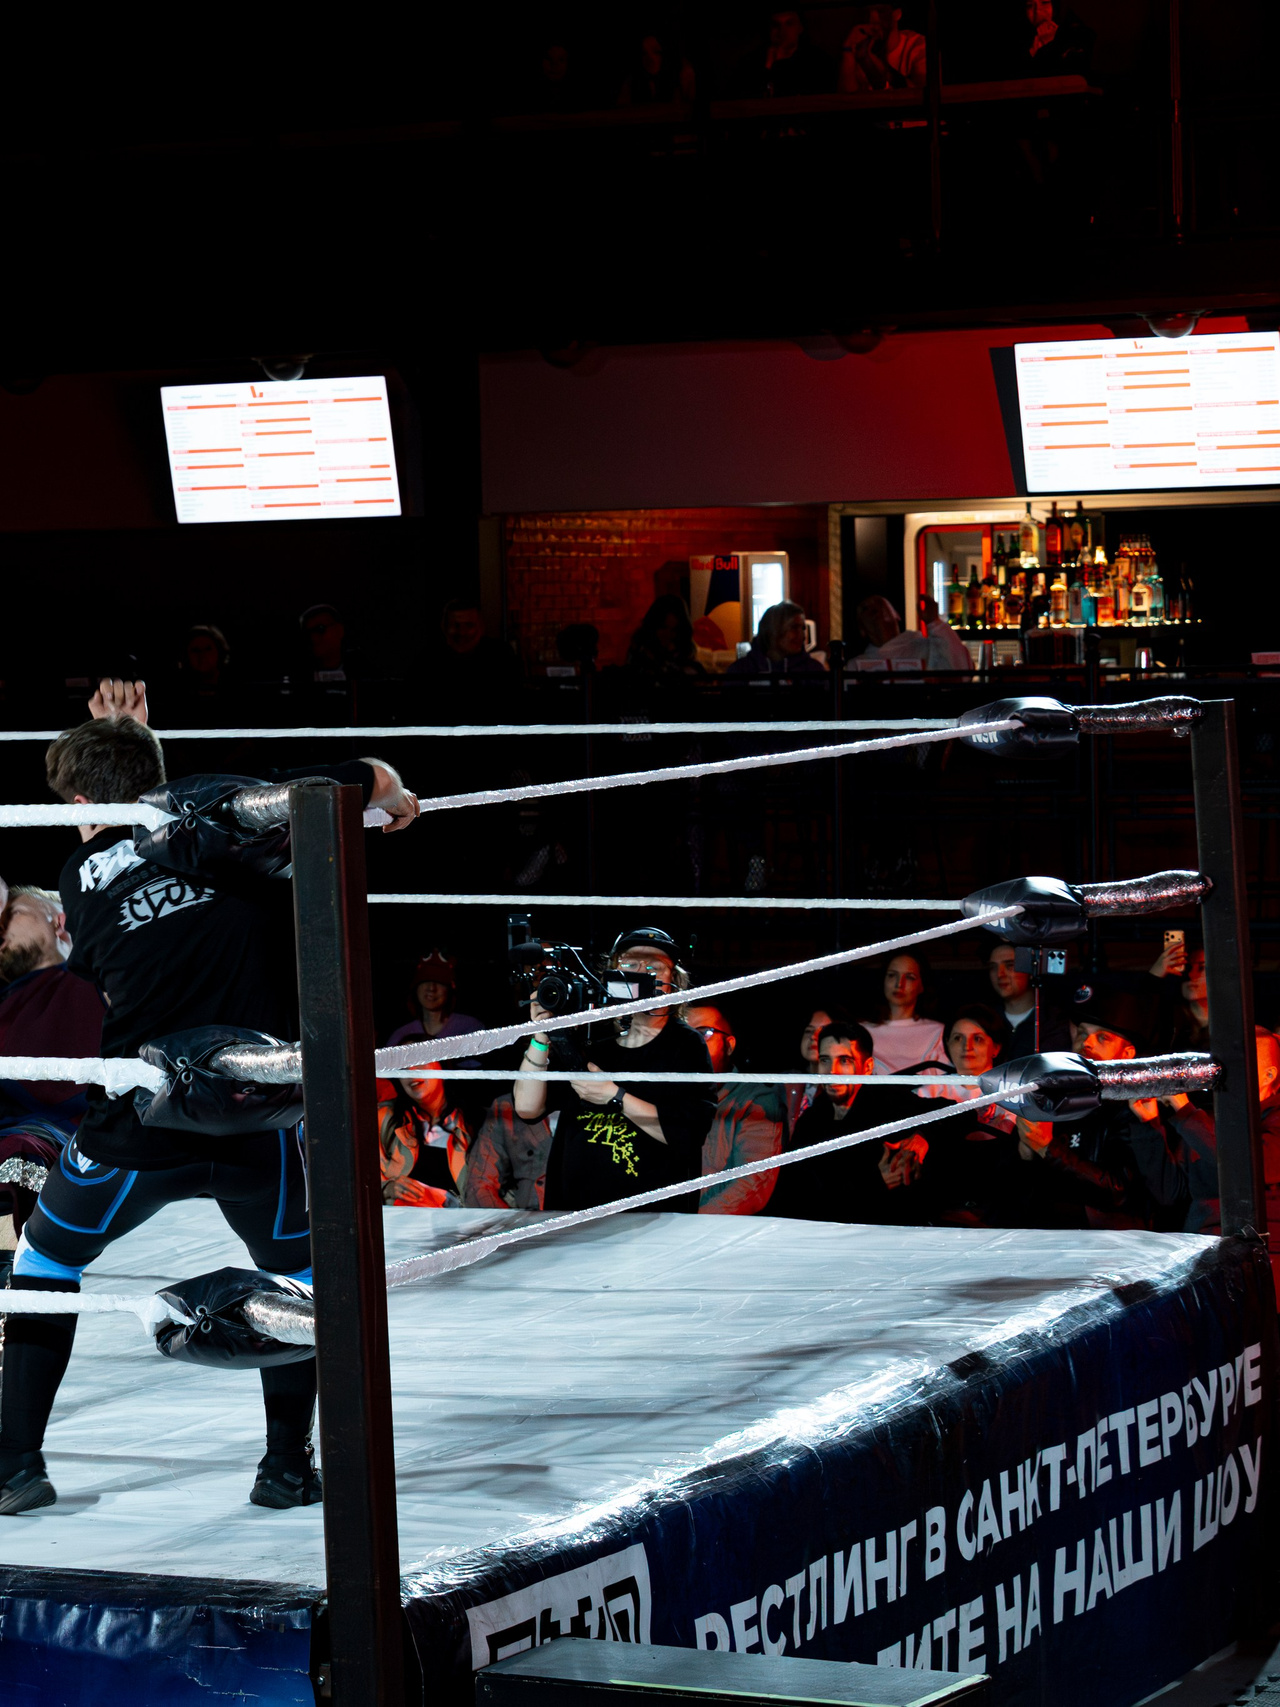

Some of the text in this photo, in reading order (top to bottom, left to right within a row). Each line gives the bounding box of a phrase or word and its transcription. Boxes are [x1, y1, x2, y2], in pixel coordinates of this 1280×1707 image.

[715, 556, 738, 570] Bull
[925, 1506, 946, 1581] В
[957, 1342, 1262, 1561] САНКТ-ПЕТЕРБУРГЕ
[995, 1562, 1041, 1664] НА
[1053, 1489, 1181, 1626] НАШИ
[1193, 1436, 1262, 1552] ШОУ
